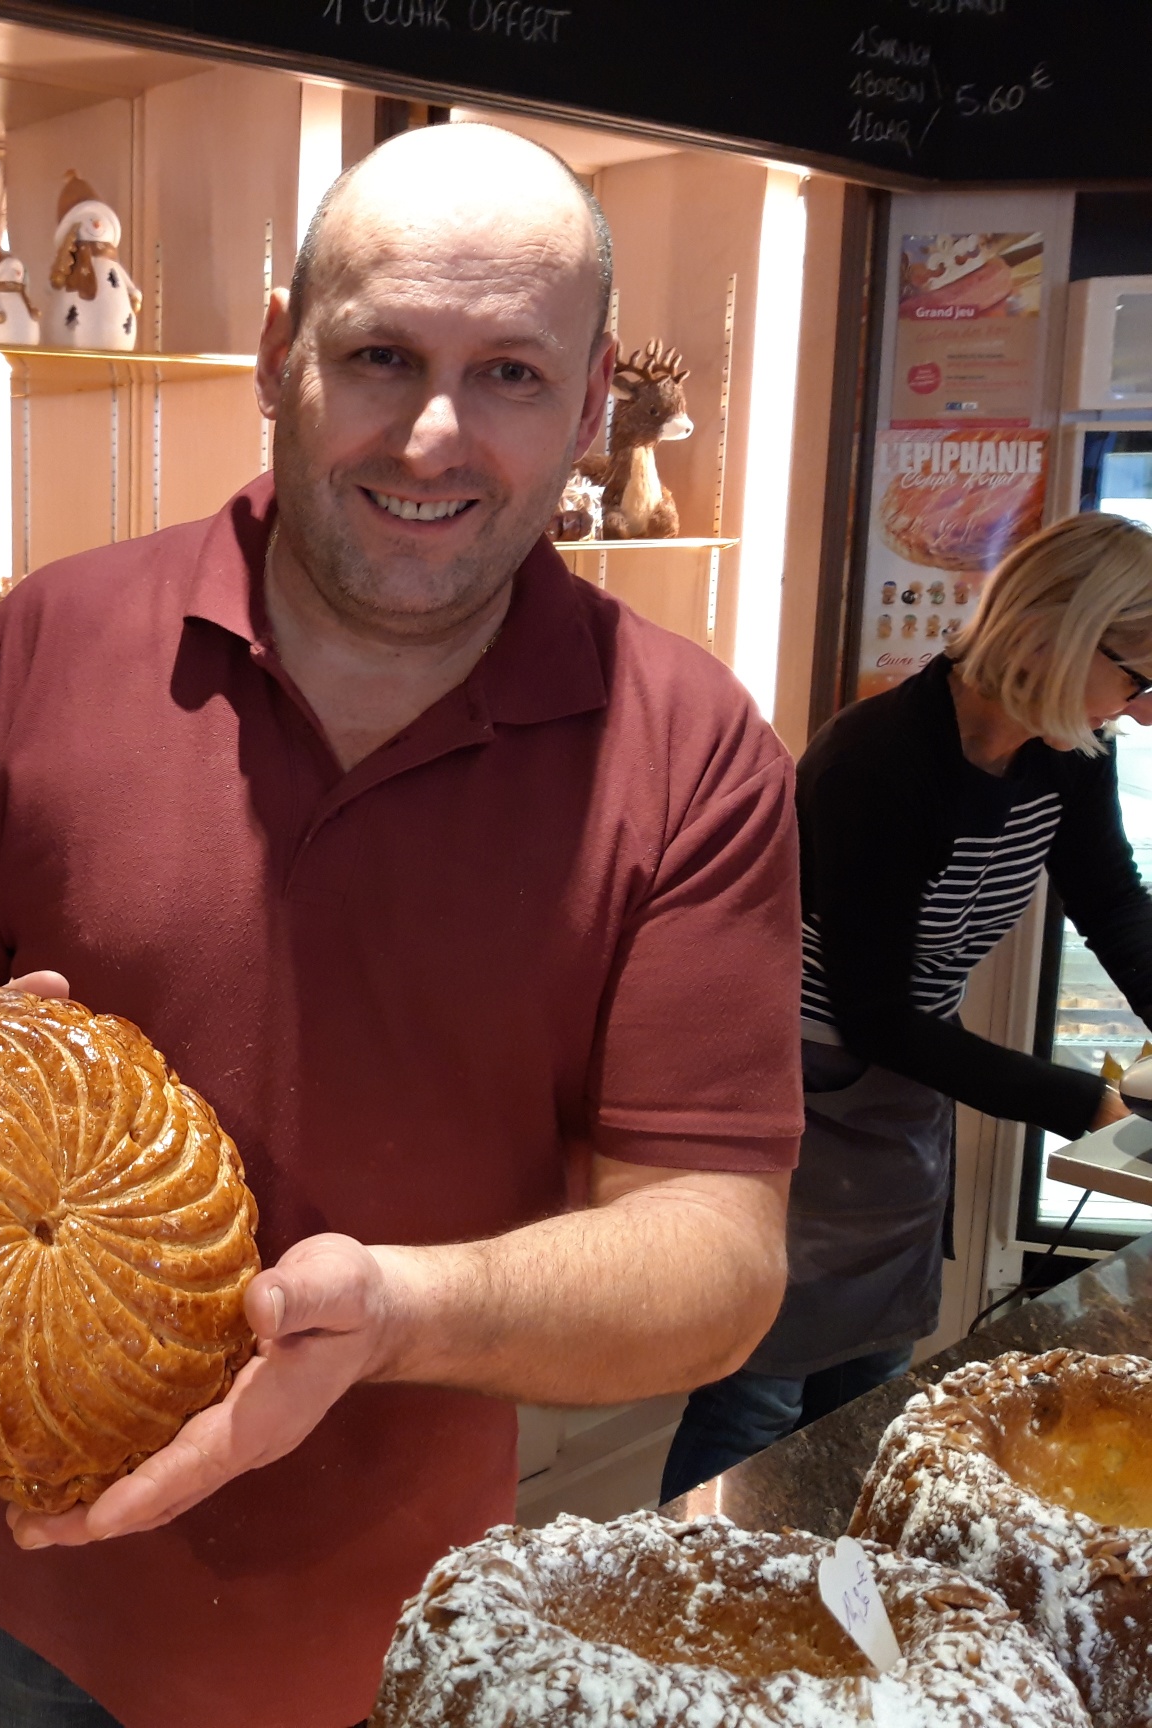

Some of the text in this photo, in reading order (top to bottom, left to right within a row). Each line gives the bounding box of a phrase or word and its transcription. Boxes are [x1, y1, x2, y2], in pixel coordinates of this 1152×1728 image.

[469, 0, 572, 43] OFFERT
[915, 306, 976, 319] Grand jeu
